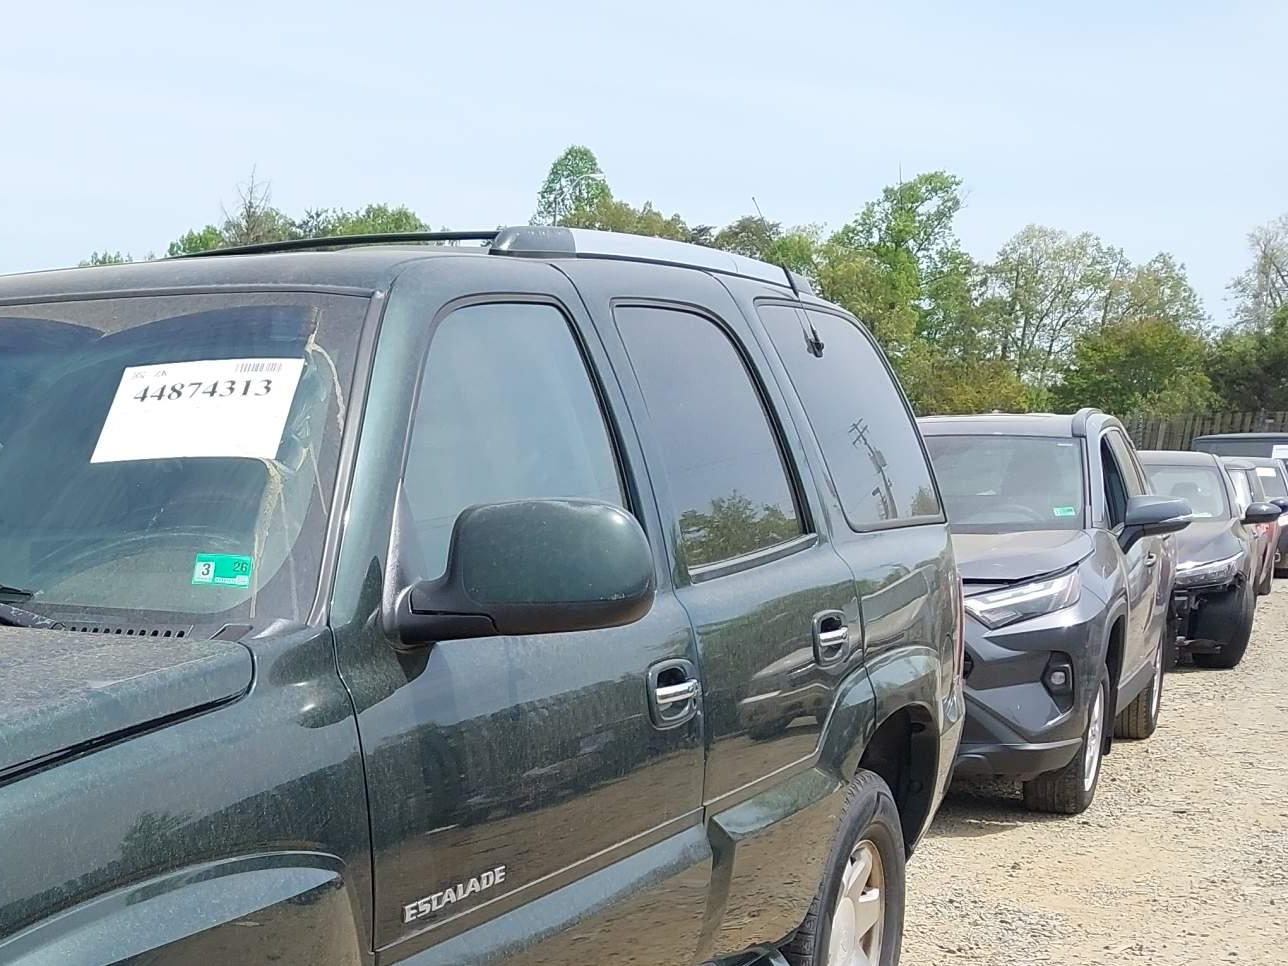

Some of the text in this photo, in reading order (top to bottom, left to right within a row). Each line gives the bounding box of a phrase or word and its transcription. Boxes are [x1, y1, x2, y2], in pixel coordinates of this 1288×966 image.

[133, 378, 273, 402] 44874313
[201, 561, 249, 576] 3 26
[403, 865, 507, 924] ESCALADE
